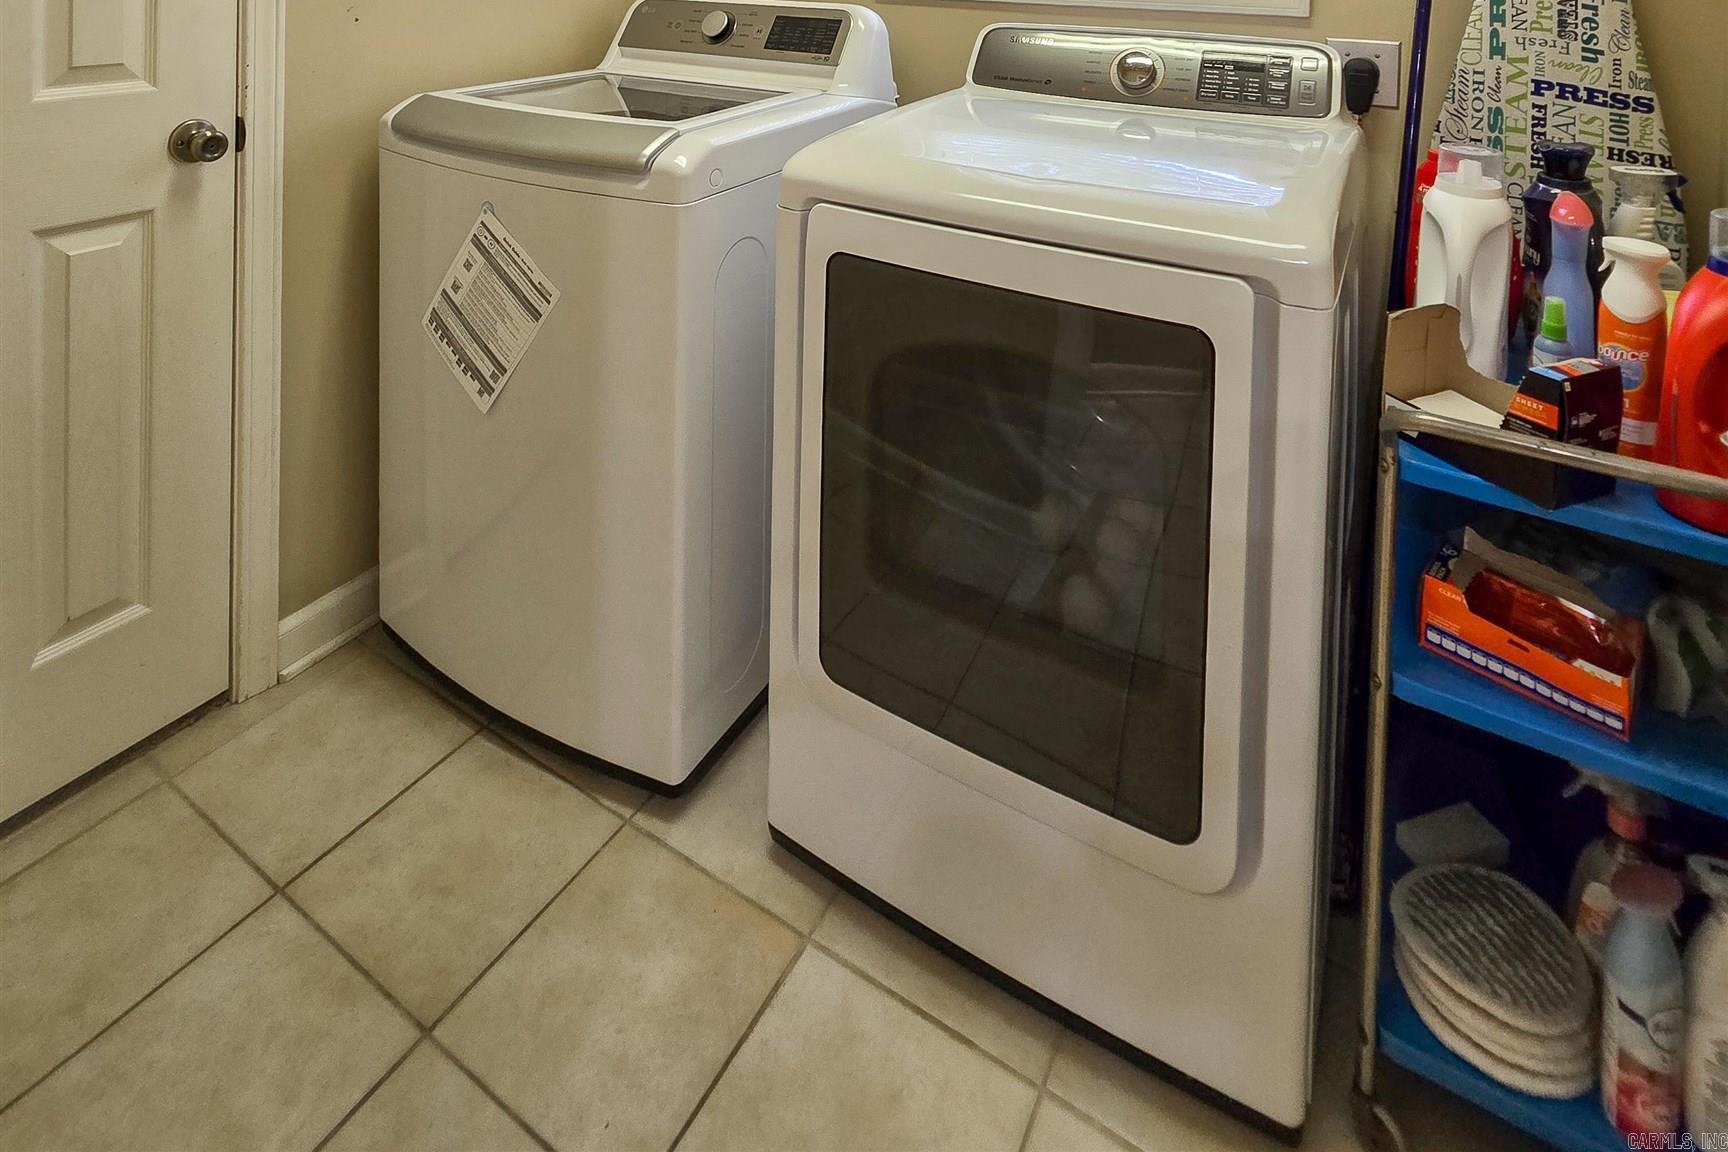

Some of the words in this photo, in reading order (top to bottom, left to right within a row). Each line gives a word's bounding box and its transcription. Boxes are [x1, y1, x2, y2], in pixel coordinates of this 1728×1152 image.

[1009, 35, 1056, 46] SAMSUNG
[1515, 36, 1571, 55] Fresh
[1608, 7, 1631, 55] Clean
[1534, 50, 1546, 78] IRON
[1547, 59, 1604, 85] Clean
[1608, 58, 1623, 90] Iron
[1471, 68, 1486, 132] IRON
[1486, 66, 1502, 103] Clean
[1530, 79, 1655, 114] PRESS
[1445, 66, 1471, 143] Steam
[1504, 55, 1529, 180] STEAM
[1530, 102, 1547, 170] FRESH
[1609, 112, 1630, 147] HOT
[1634, 116, 1655, 150] Press
